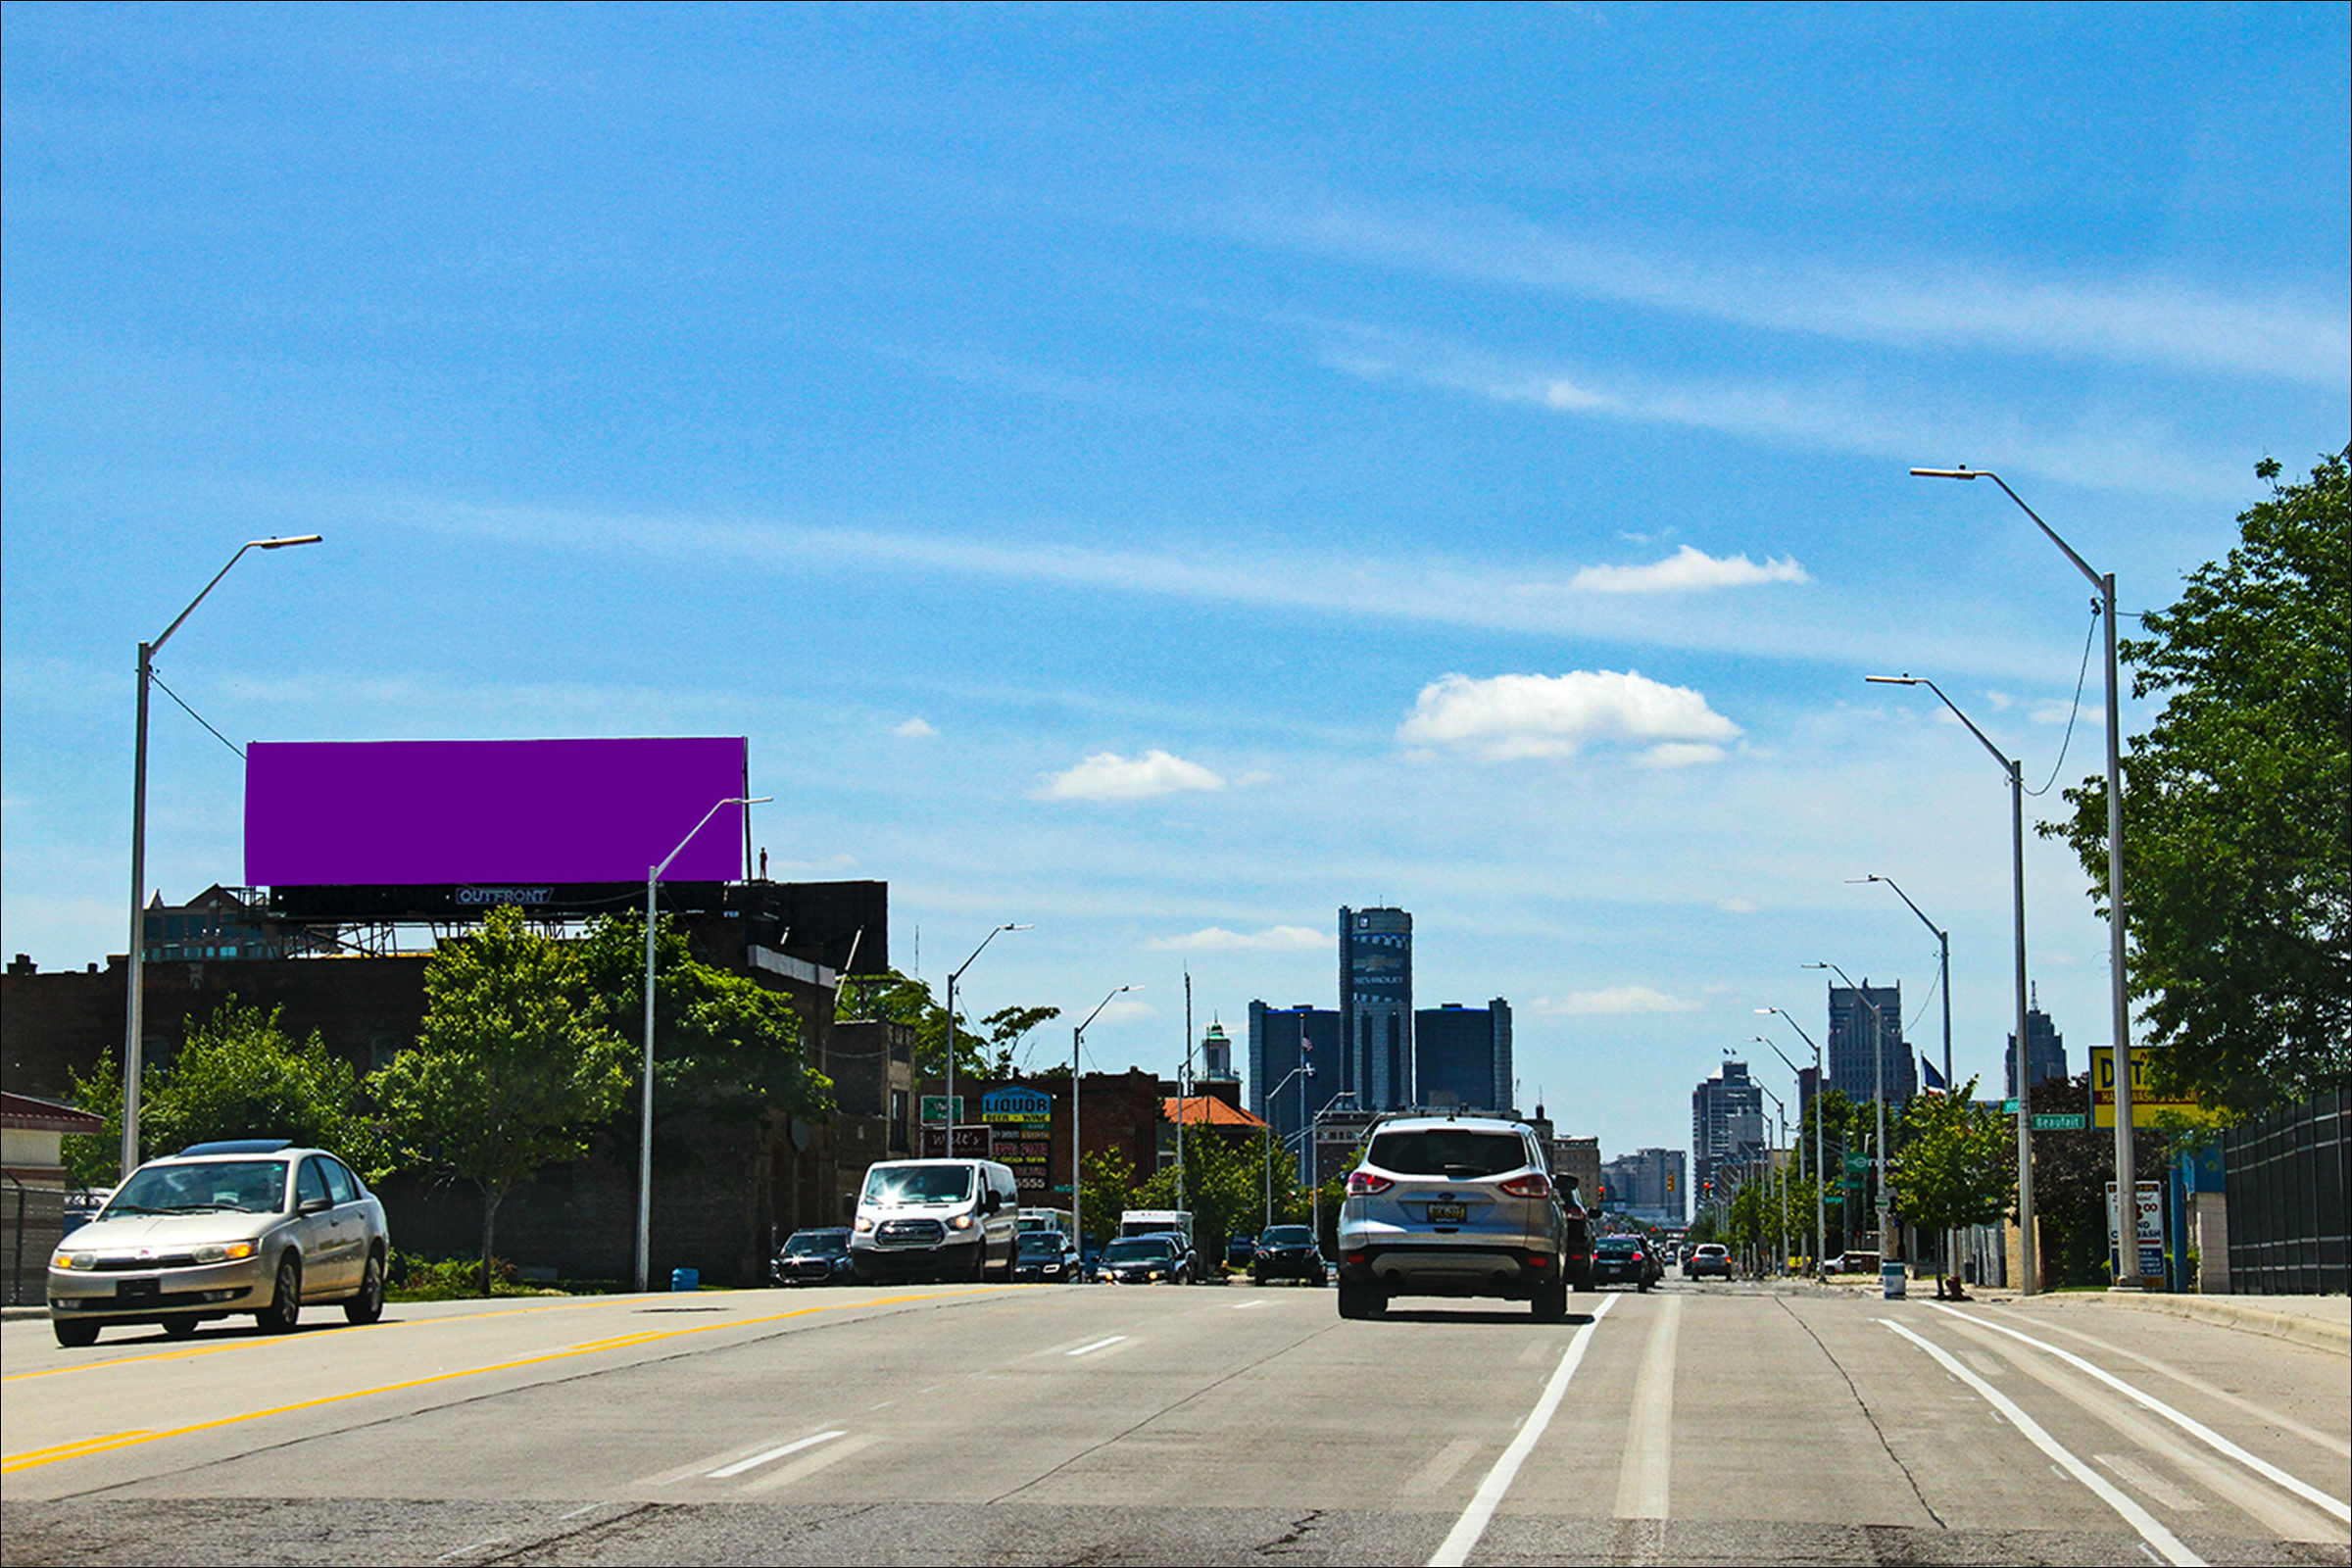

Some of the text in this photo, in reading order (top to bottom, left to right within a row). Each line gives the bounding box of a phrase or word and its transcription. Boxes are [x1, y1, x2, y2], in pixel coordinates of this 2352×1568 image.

[460, 889, 547, 902] OUTFRONT
[986, 1099, 1048, 1112] LIQUOR
[2036, 1117, 2079, 1129] Beaufait
[933, 1132, 981, 1146] Wlt's
